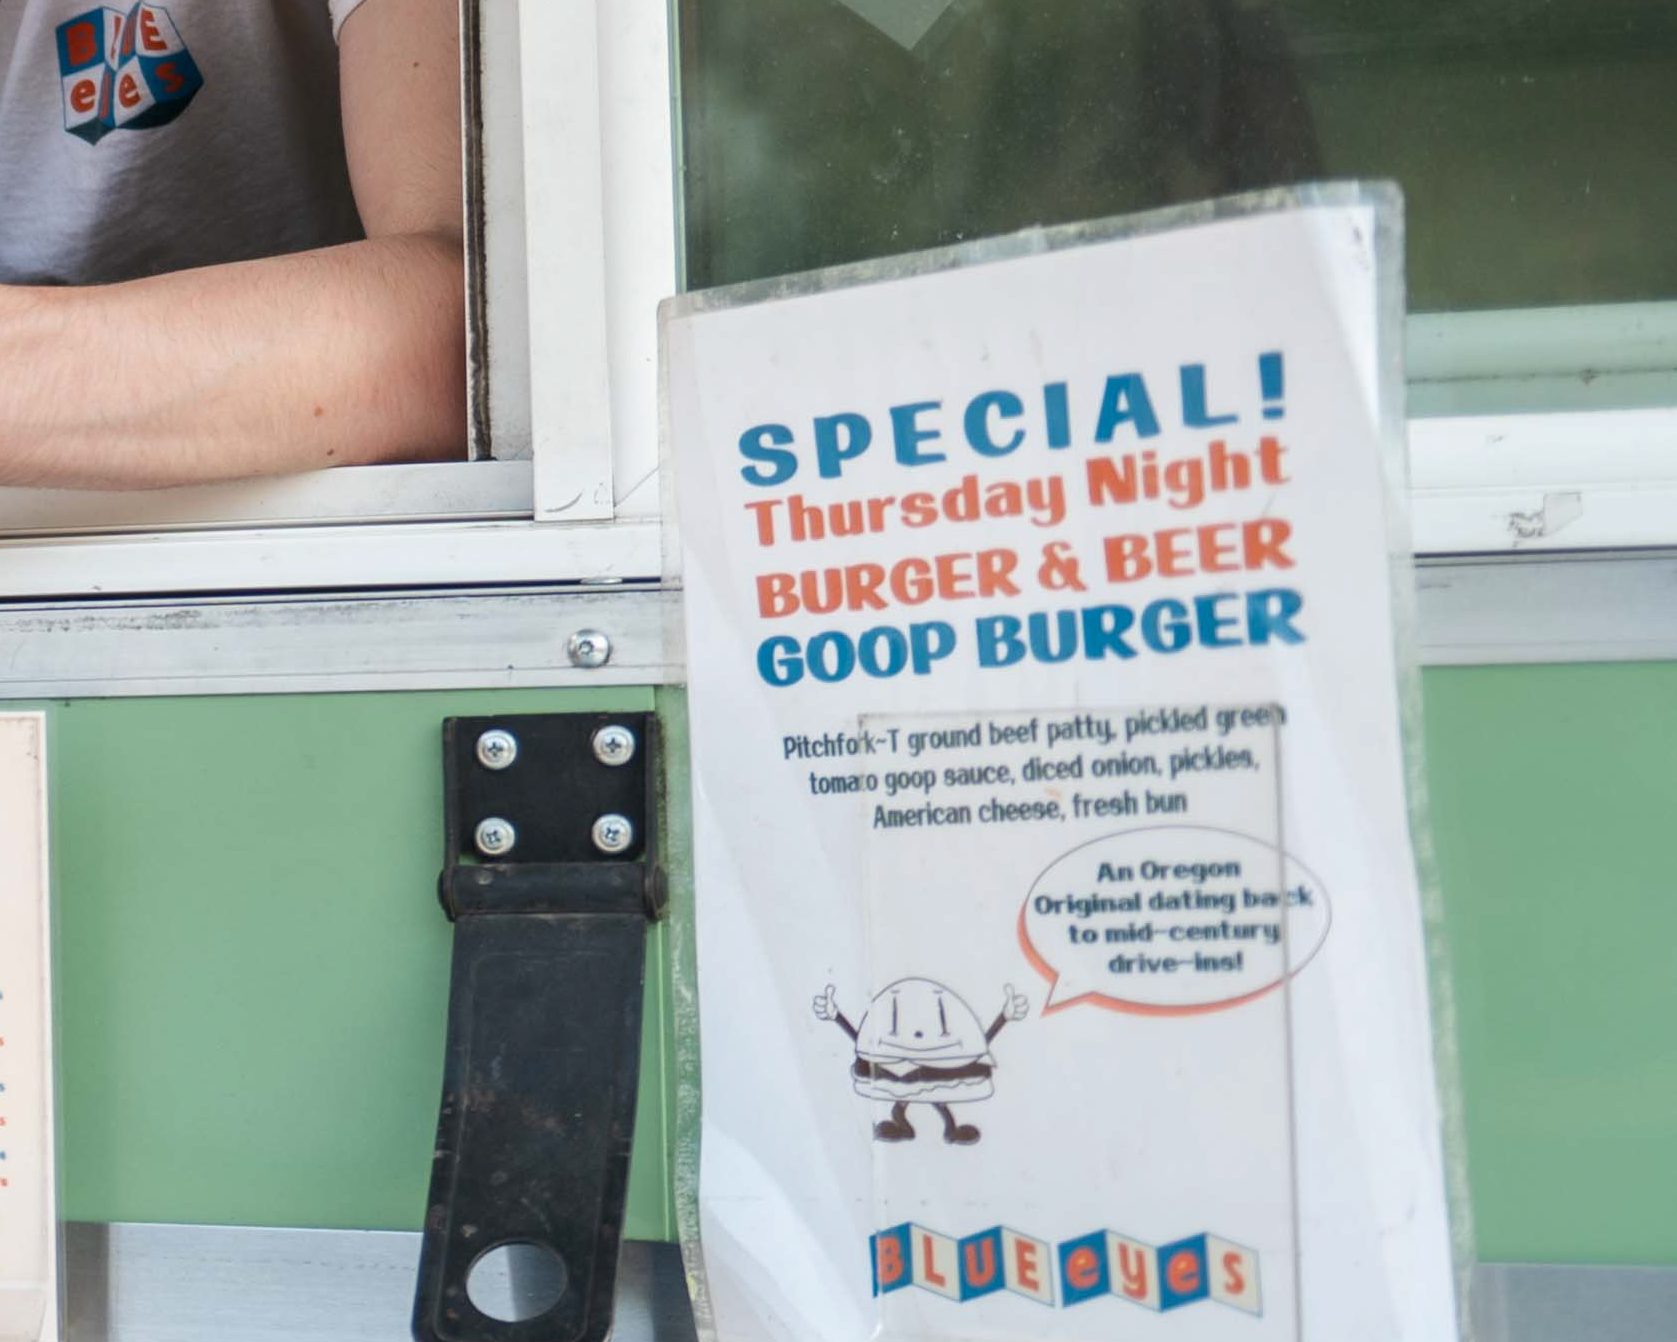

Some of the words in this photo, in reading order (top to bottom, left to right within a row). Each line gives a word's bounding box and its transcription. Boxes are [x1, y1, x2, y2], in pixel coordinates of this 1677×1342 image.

[737, 351, 1288, 488] SPECIAL!
[744, 473, 1067, 547] Thursday
[1086, 435, 1291, 510] Night
[755, 547, 1022, 620] BURGER
[1038, 541, 1087, 593] &
[1103, 518, 1296, 586] BEER
[756, 620, 956, 688] GOOP
[977, 588, 1307, 669] BURGER
[907, 722, 982, 756] ground
[988, 717, 1038, 746] beef
[1047, 715, 1118, 749] patty,
[1125, 705, 1208, 744] pickled
[1215, 705, 1287, 737] green
[884, 769, 936, 797] goop
[943, 764, 1016, 787] sauce,
[1022, 754, 1084, 782] diced
[1090, 750, 1163, 778] onion,
[1169, 744, 1260, 781] pickles,
[873, 801, 972, 829] American
[978, 798, 1067, 823] cheese,
[1072, 789, 1139, 819] fresh
[1145, 789, 1189, 813] bun
[1097, 862, 1134, 883] An
[1140, 860, 1241, 884] Oregon
[1034, 892, 1141, 919] Original
[1148, 889, 1237, 915] dating
[1068, 924, 1099, 944] to
[876, 1233, 1040, 1292] BLUE
